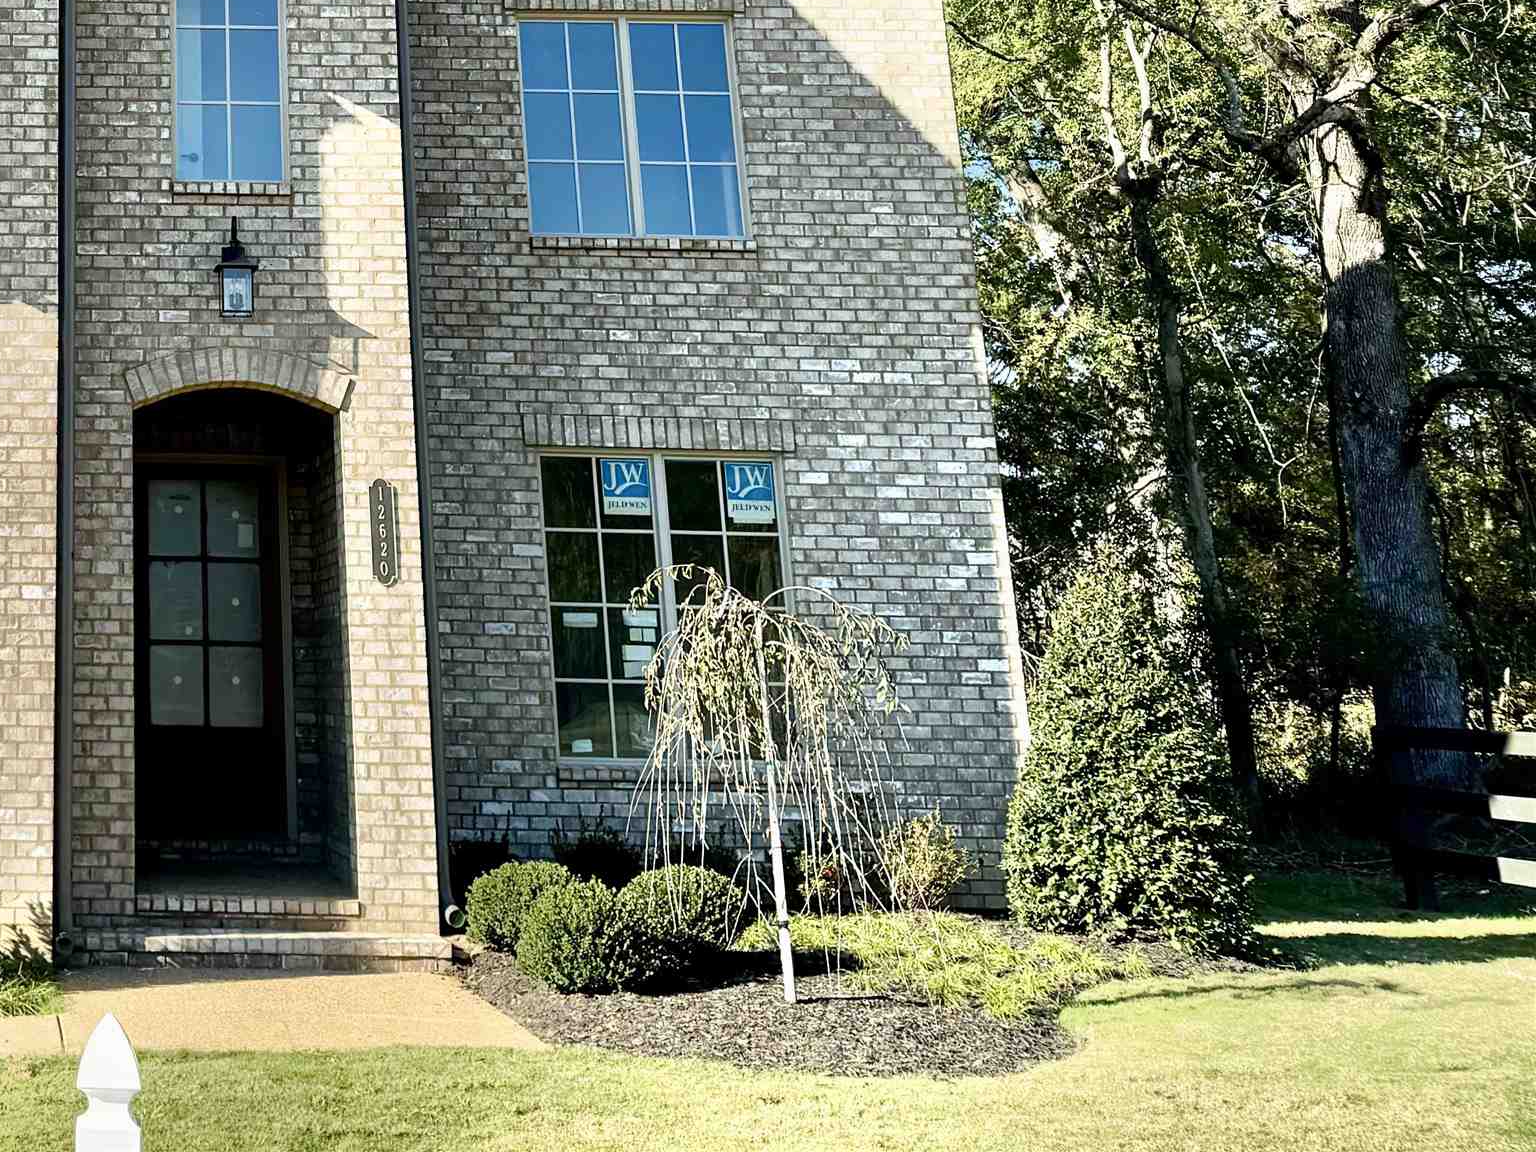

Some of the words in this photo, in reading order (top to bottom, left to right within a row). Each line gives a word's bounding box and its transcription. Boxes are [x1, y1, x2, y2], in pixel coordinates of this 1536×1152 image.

[604, 462, 645, 490] JW
[727, 465, 769, 493] JW
[377, 486, 389, 577] 12620
